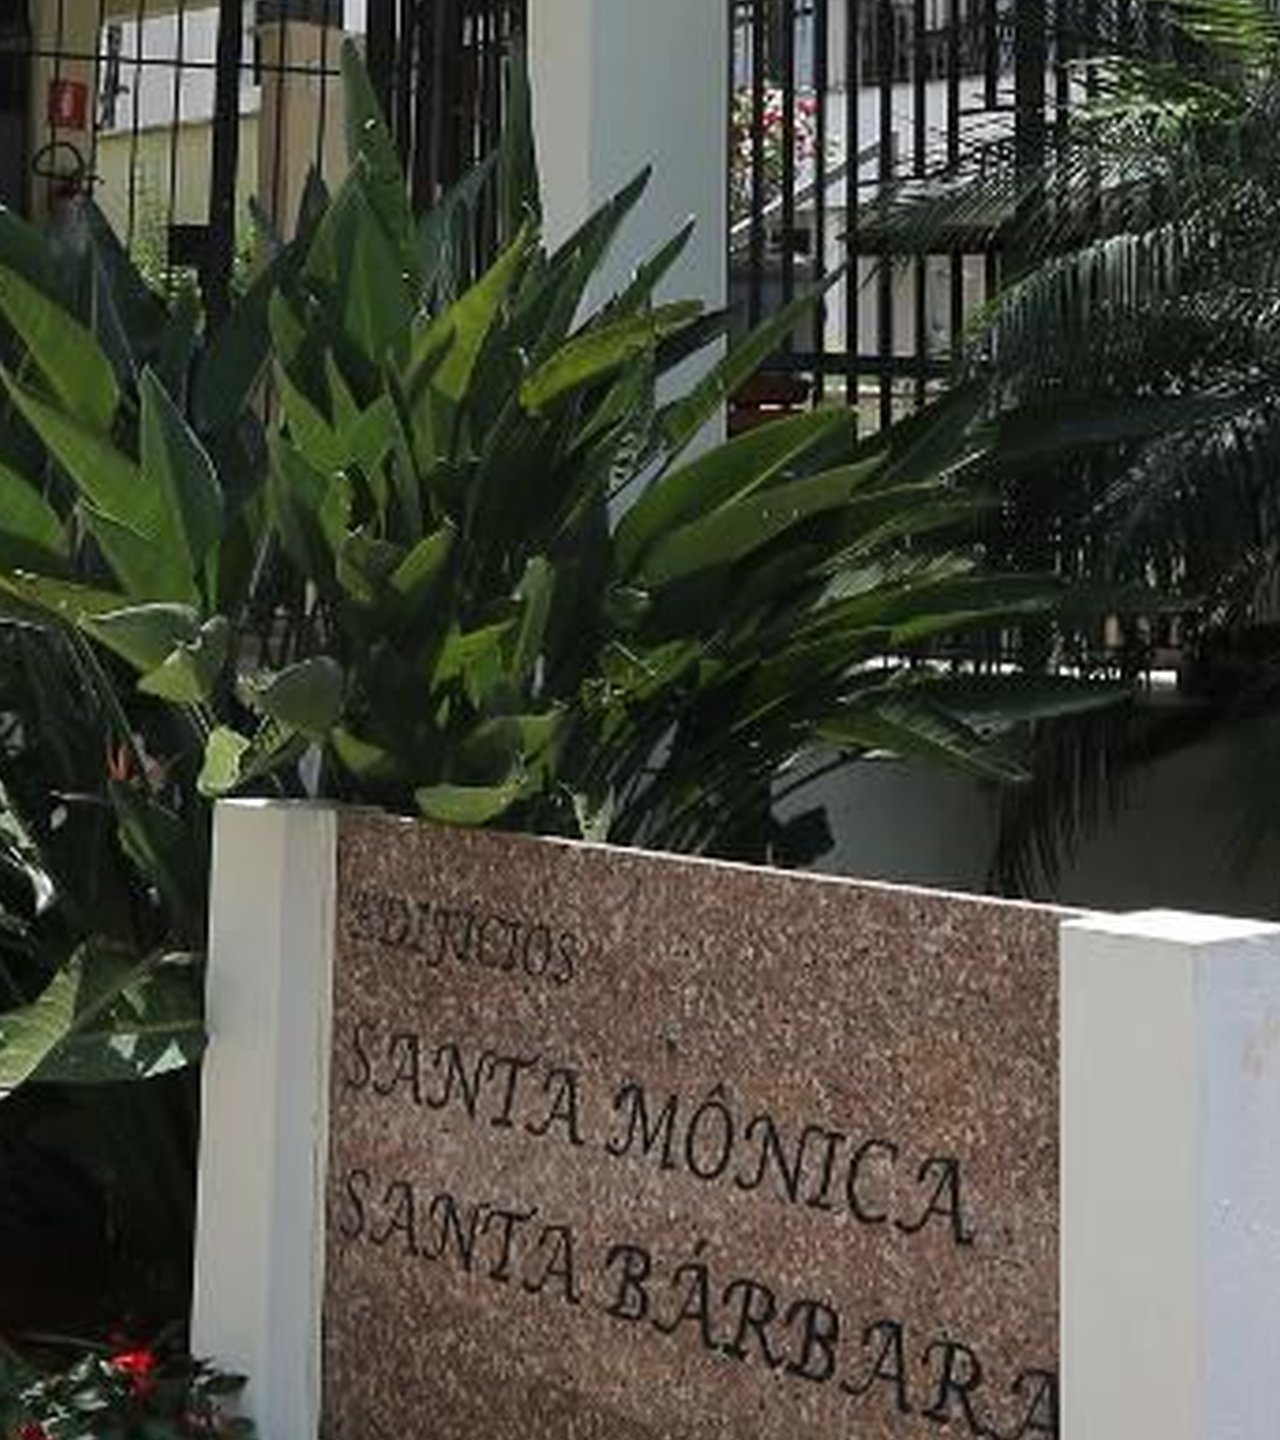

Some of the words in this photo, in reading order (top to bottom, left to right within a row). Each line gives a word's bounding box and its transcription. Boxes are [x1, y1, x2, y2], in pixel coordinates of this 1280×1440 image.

[346, 1022, 584, 1147] SANTA
[605, 1083, 974, 1247] MÔNICA
[340, 1169, 581, 1305] SANTA
